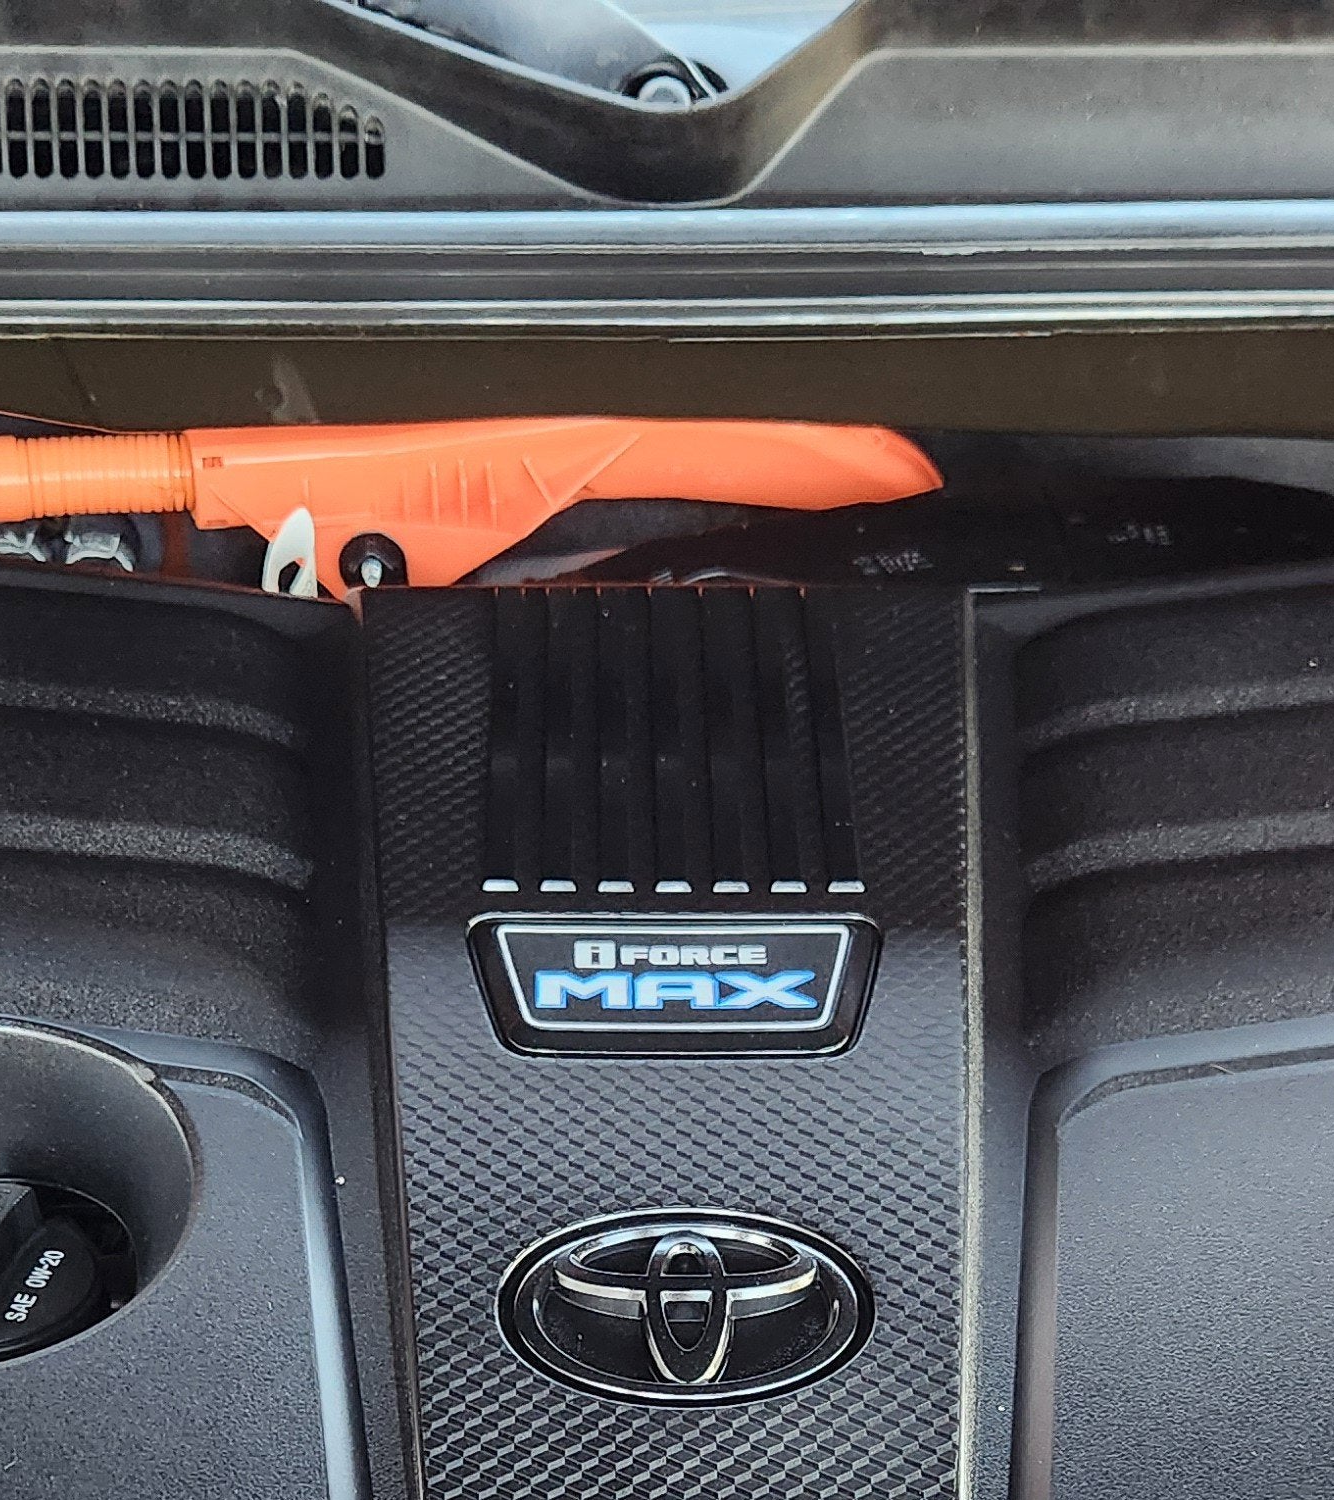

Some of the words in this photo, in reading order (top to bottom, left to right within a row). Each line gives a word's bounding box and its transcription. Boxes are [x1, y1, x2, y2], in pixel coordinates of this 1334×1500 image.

[620, 944, 768, 966] FORCE
[534, 969, 819, 1010] MAX
[5, 1292, 38, 1323] SAE
[24, 1249, 66, 1290] 0W-20
